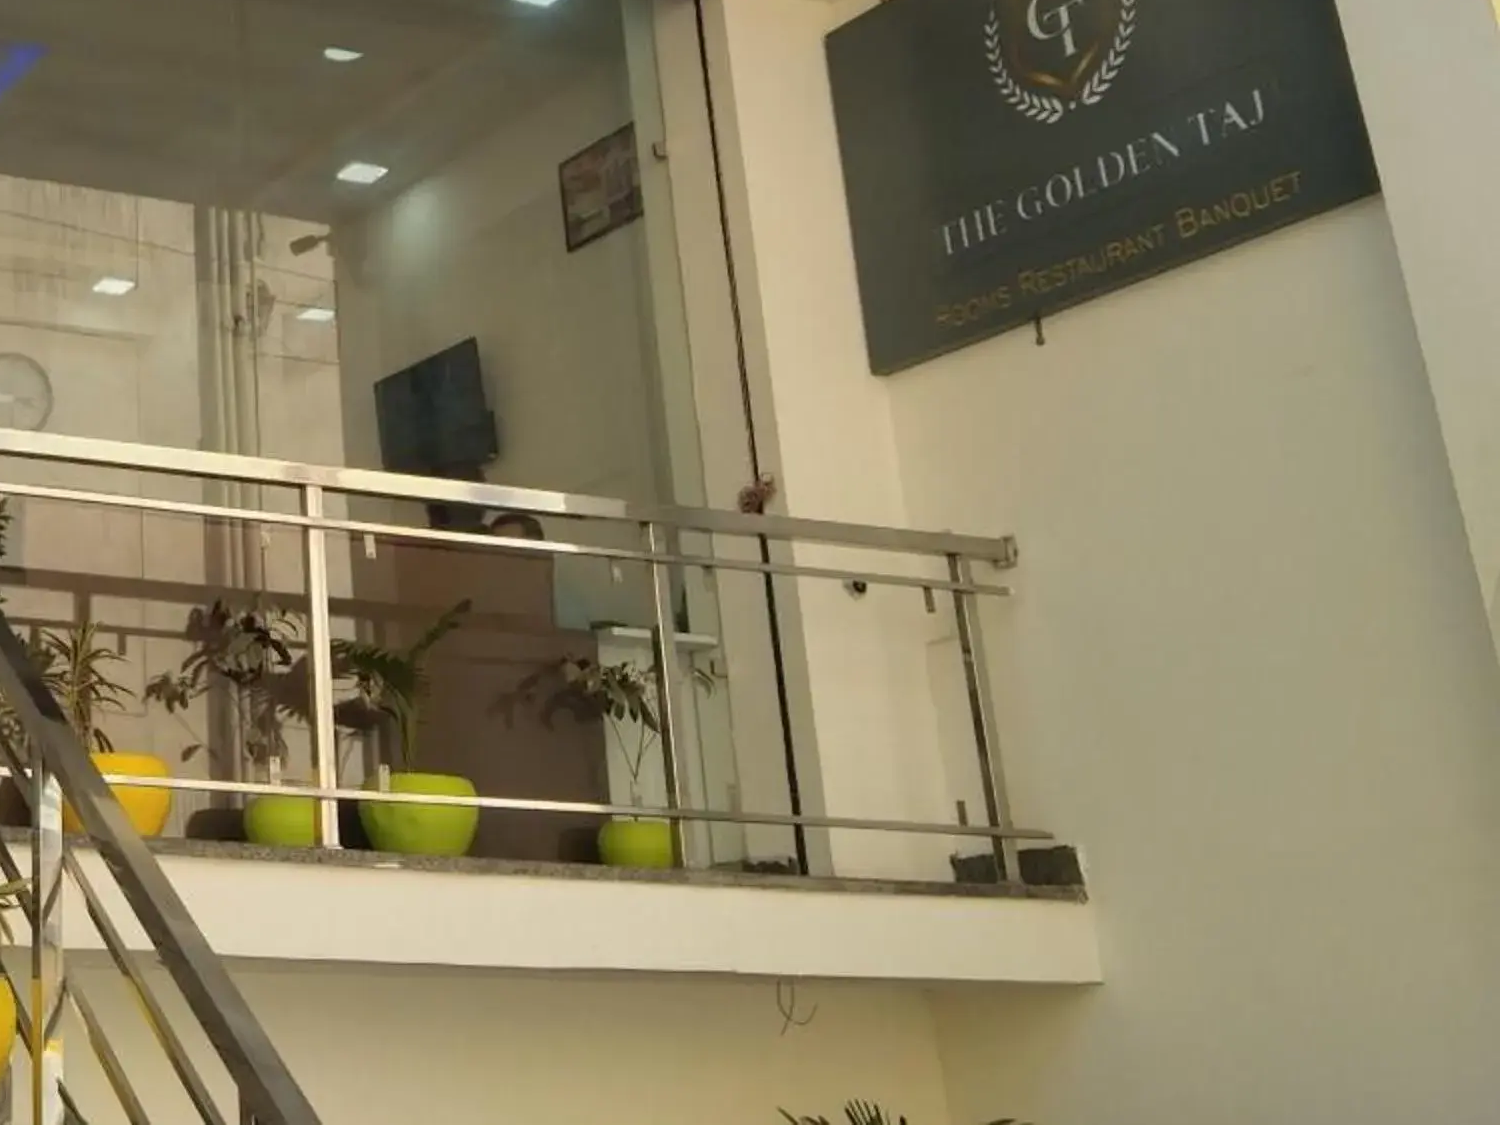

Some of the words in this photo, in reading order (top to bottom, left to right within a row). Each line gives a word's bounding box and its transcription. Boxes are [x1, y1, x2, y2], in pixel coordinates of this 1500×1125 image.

[936, 199, 1006, 256] THE
[1017, 127, 1180, 220] GOLDEN
[1188, 88, 1268, 147] TAJ
[1175, 170, 1302, 238] BANQUET
